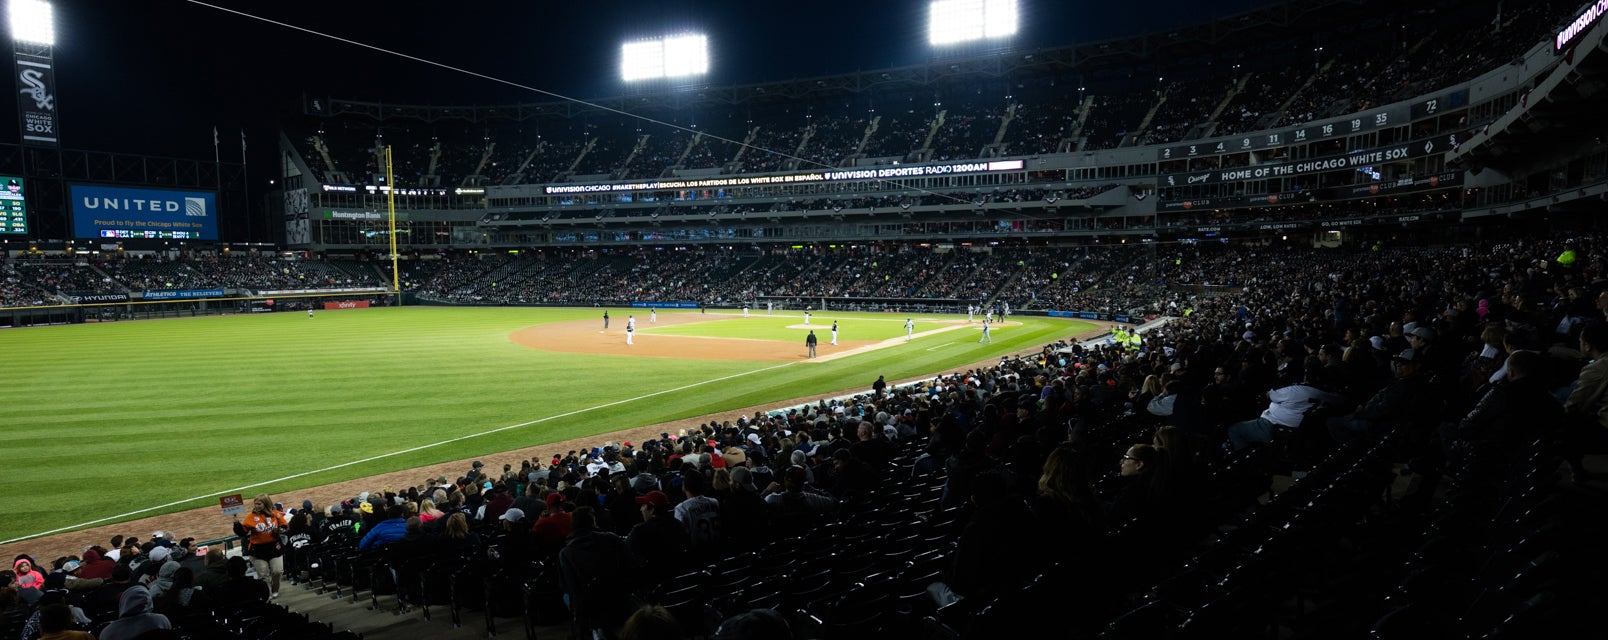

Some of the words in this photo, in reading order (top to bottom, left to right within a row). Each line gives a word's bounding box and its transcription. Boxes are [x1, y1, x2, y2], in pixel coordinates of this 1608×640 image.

[1562, 5, 1597, 44] UNIVISION
[1425, 100, 1437, 112] 72
[1376, 112, 1387, 124] 35
[26, 124, 53, 133] SOX
[1322, 124, 1333, 133] 16
[1351, 119, 1361, 128] 19
[1269, 134, 1278, 143] 11
[1296, 129, 1306, 138] 14
[1243, 138, 1250, 146] 9
[1222, 169, 1252, 180] HOME
[1254, 167, 1270, 178] OF
[1273, 164, 1294, 175] THE
[1296, 158, 1346, 172] CHICAGO
[1349, 151, 1383, 166] WHITE
[1385, 147, 1408, 159] SOX
[832, 170, 877, 180] UNIVISION
[878, 168, 923, 177] DEPORTES
[925, 165, 952, 174] RADIO
[952, 163, 987, 172] 1200AM
[1188, 172, 1210, 184] Chicago
[1439, 174, 1455, 182] CLUB
[84, 196, 179, 212] UNITED
